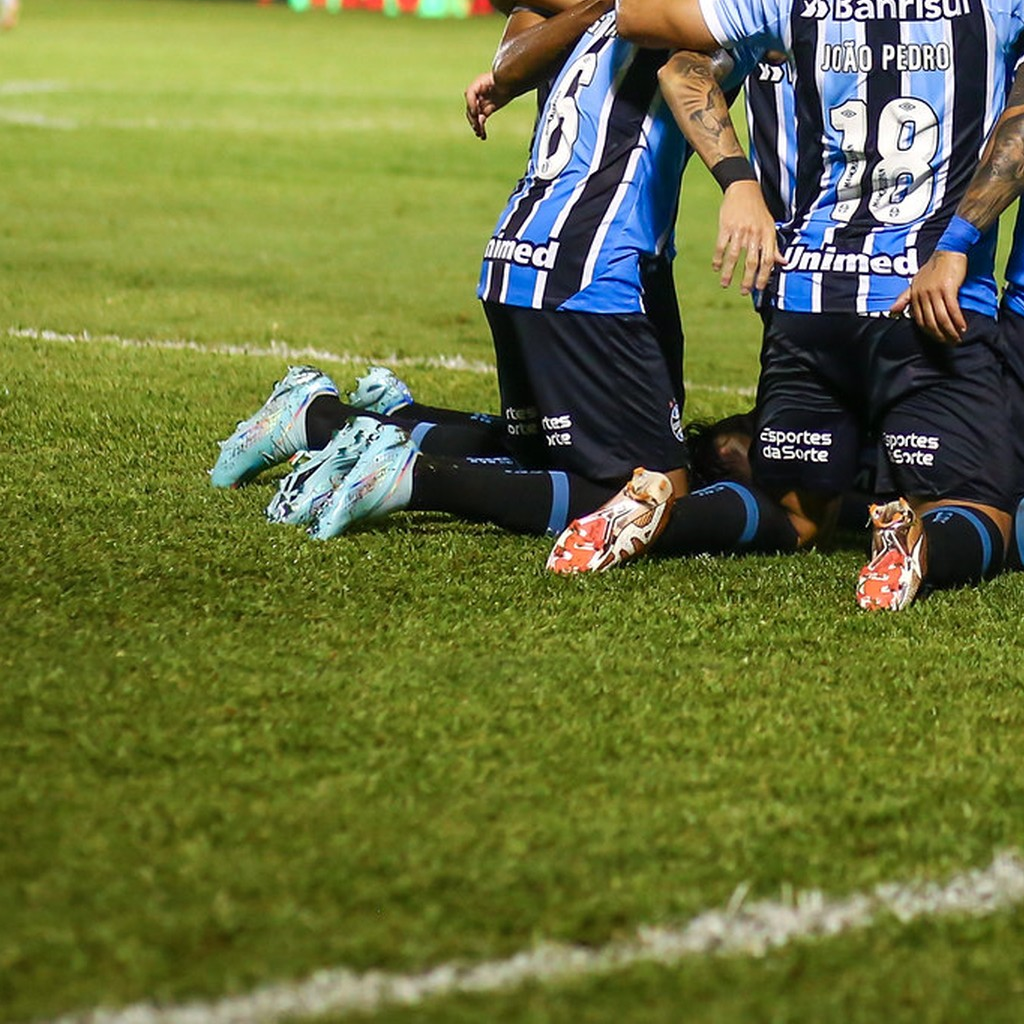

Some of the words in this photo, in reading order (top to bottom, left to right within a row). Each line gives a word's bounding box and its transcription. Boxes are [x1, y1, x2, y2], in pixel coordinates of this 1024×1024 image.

[821, 40, 873, 72] JOÃO
[882, 43, 951, 72] PEDRO
[830, 96, 940, 224] 18
[484, 237, 560, 270] nimed
[782, 244, 919, 275] Unimed
[760, 428, 832, 446] Esportes
[883, 432, 940, 450] sportes
